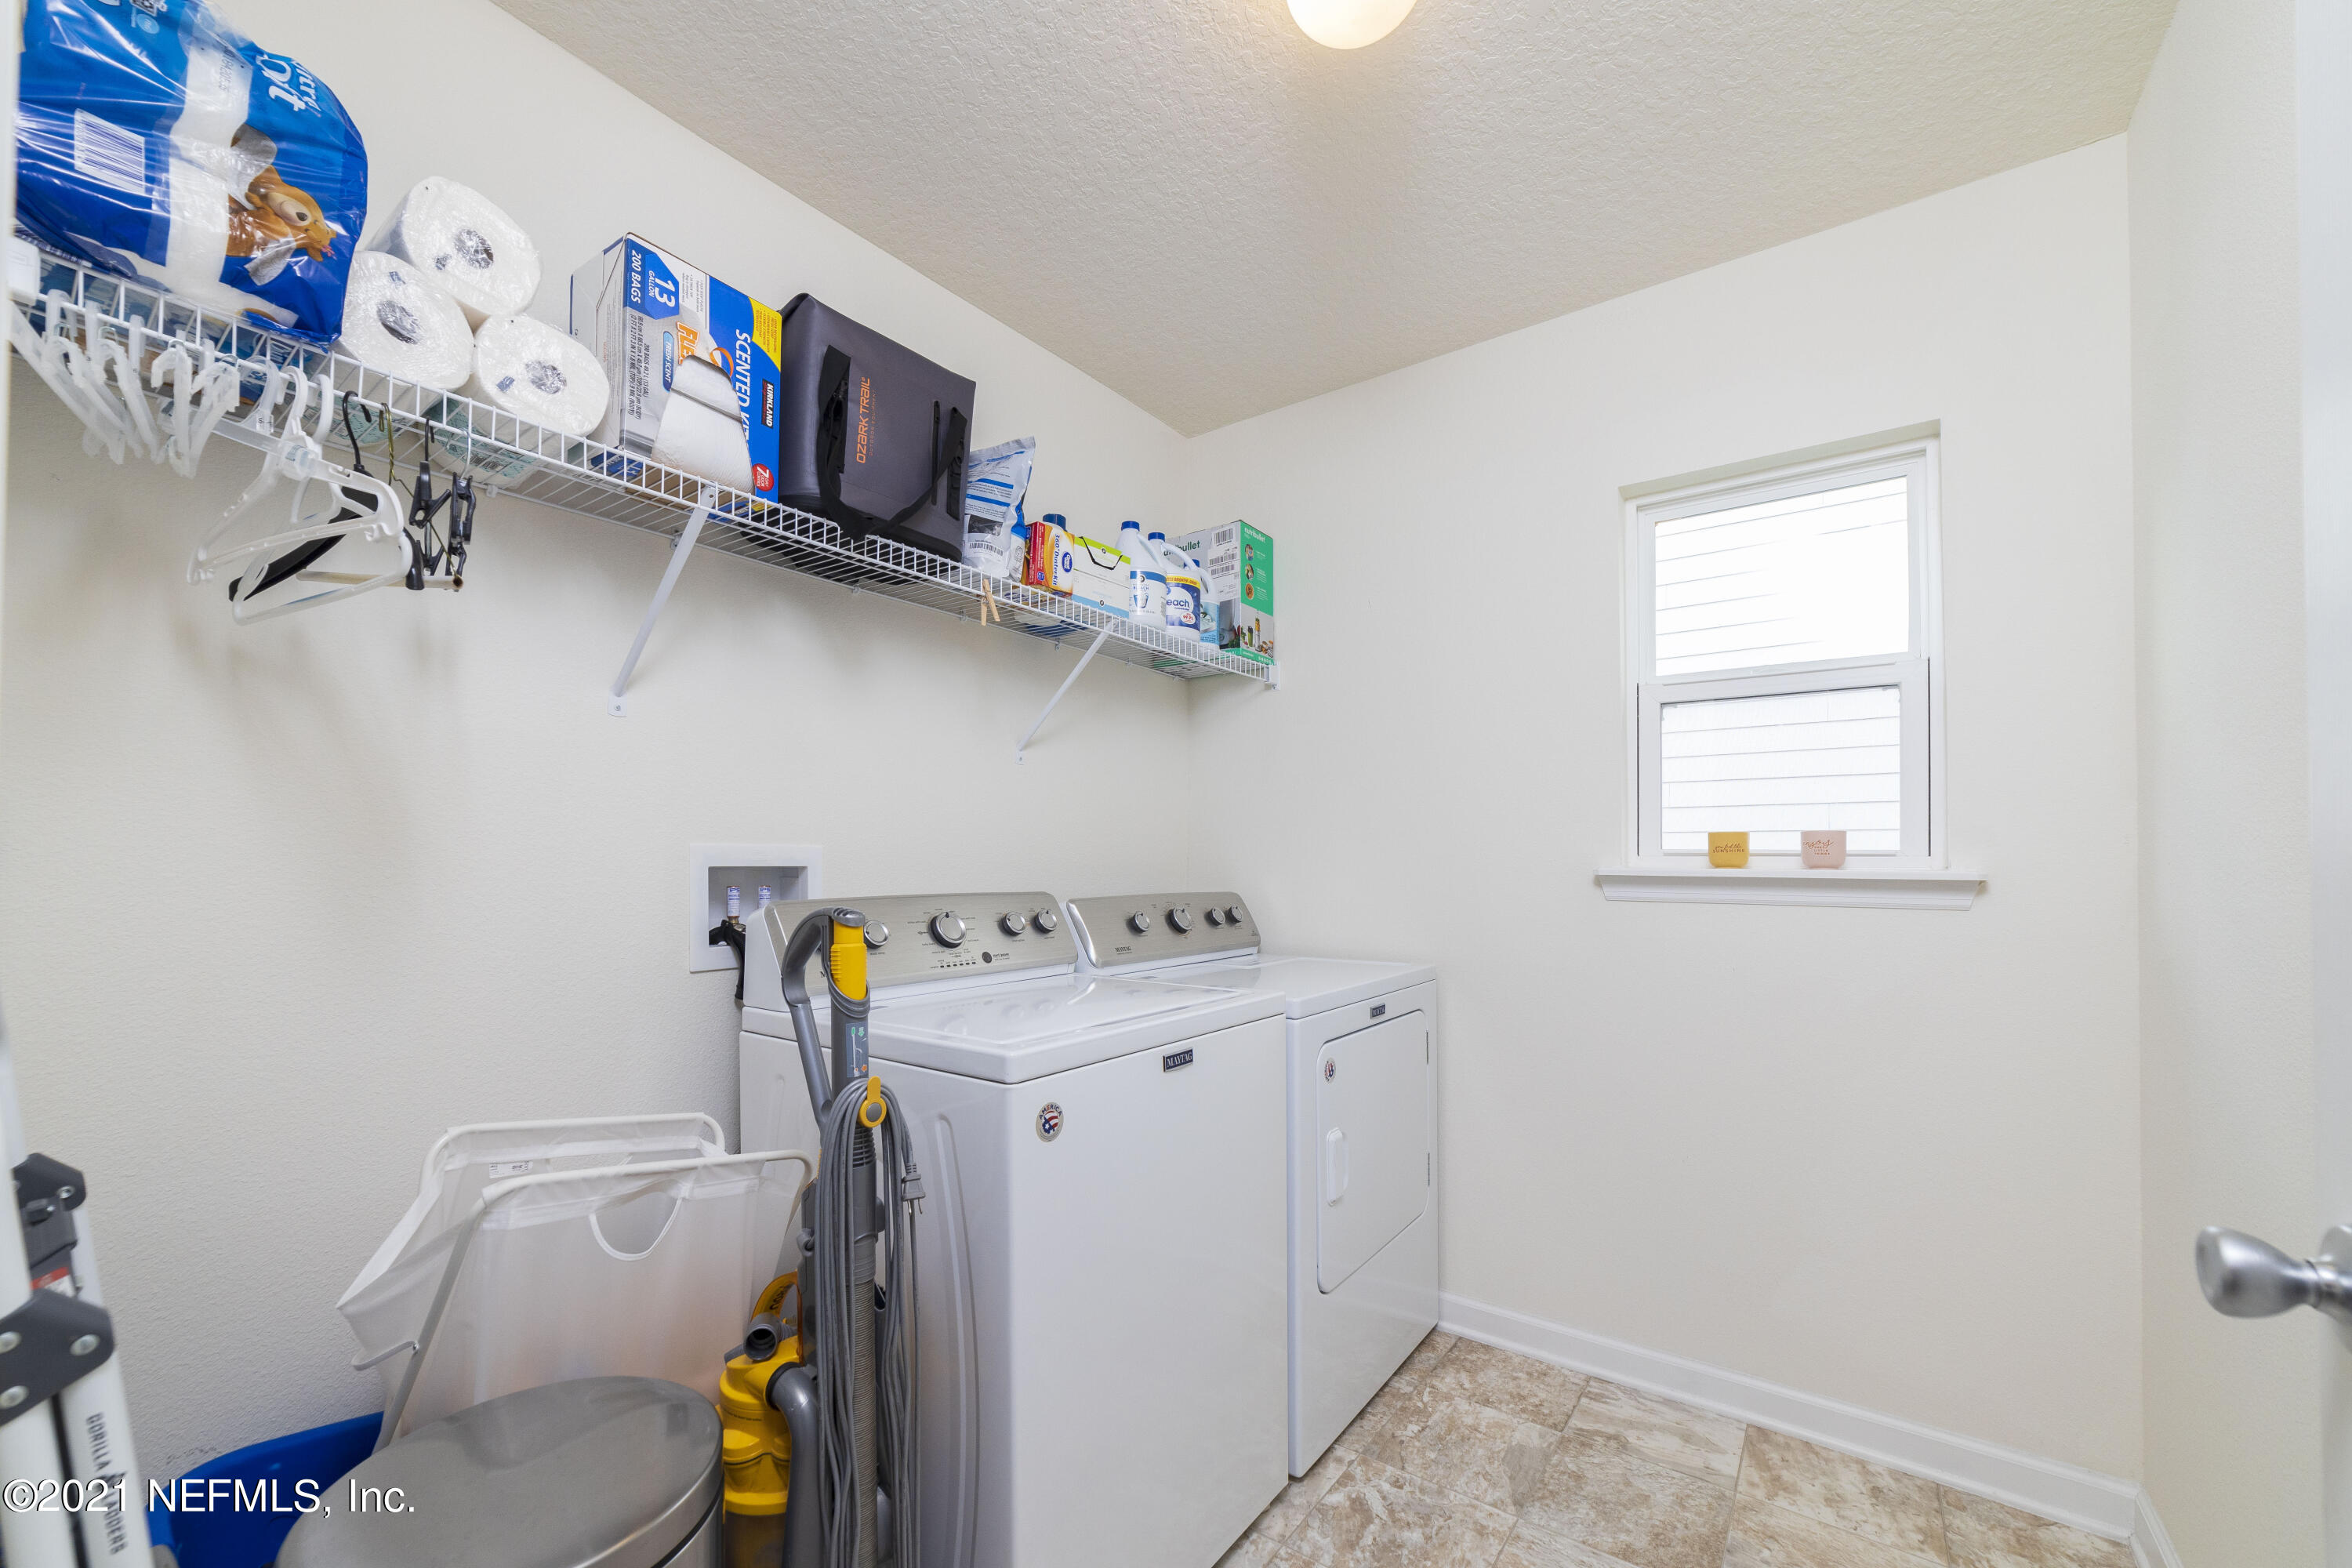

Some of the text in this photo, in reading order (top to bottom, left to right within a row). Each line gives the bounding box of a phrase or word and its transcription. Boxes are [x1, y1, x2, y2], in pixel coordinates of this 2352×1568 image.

[630, 249, 641, 304] 200 BAGS
[655, 278, 676, 307] 13
[676, 321, 701, 365] FLE
[735, 329, 751, 408] SCENTED
[757, 466, 769, 478] 7
[1167, 1052, 1192, 1067] MAYTAG
[1039, 1104, 1062, 1120] AMERICA
[85, 1412, 111, 1472] GORILLA
